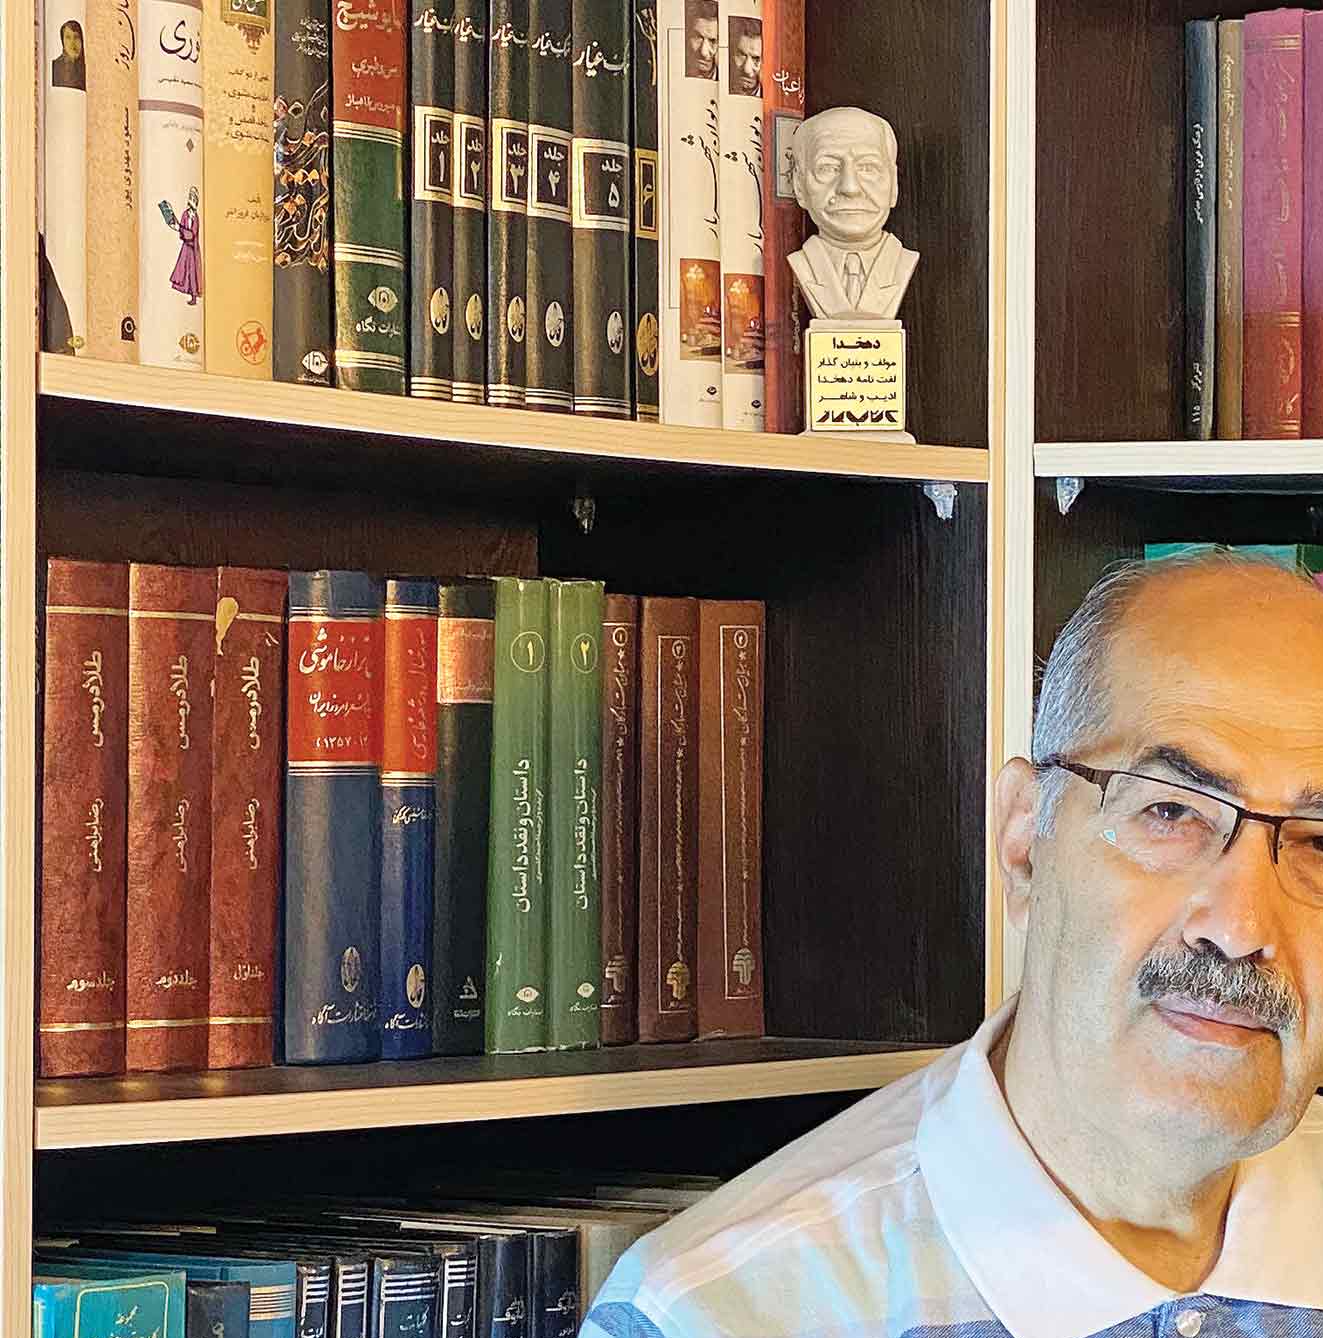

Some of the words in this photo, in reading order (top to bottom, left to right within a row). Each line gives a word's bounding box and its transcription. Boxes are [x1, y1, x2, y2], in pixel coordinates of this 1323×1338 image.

[544, 146, 565, 167] جلد
[601, 159, 623, 179] جلد
[470, 160, 481, 190] ۲
[508, 161, 525, 195] ۳
[548, 170, 561, 197] ۴
[608, 182, 620, 208] ۵
[833, 337, 881, 349] دهخدا
[841, 358, 861, 368] بنیان
[864, 360, 868, 369] و
[872, 358, 896, 370] مولف
[876, 375, 896, 383] لغت
[819, 391, 857, 402] شاعر
[867, 392, 896, 401] ادیب
[89, 686, 105, 714] در
[92, 704, 104, 747] مس
[512, 759, 531, 816] داستان
[573, 758, 588, 814] داستان
[519, 816, 533, 828] و
[579, 815, 591, 827] و
[513, 826, 529, 854] نقد
[575, 825, 587, 853] نقد
[512, 854, 531, 913] داستان
[573, 852, 588, 910] داستان
